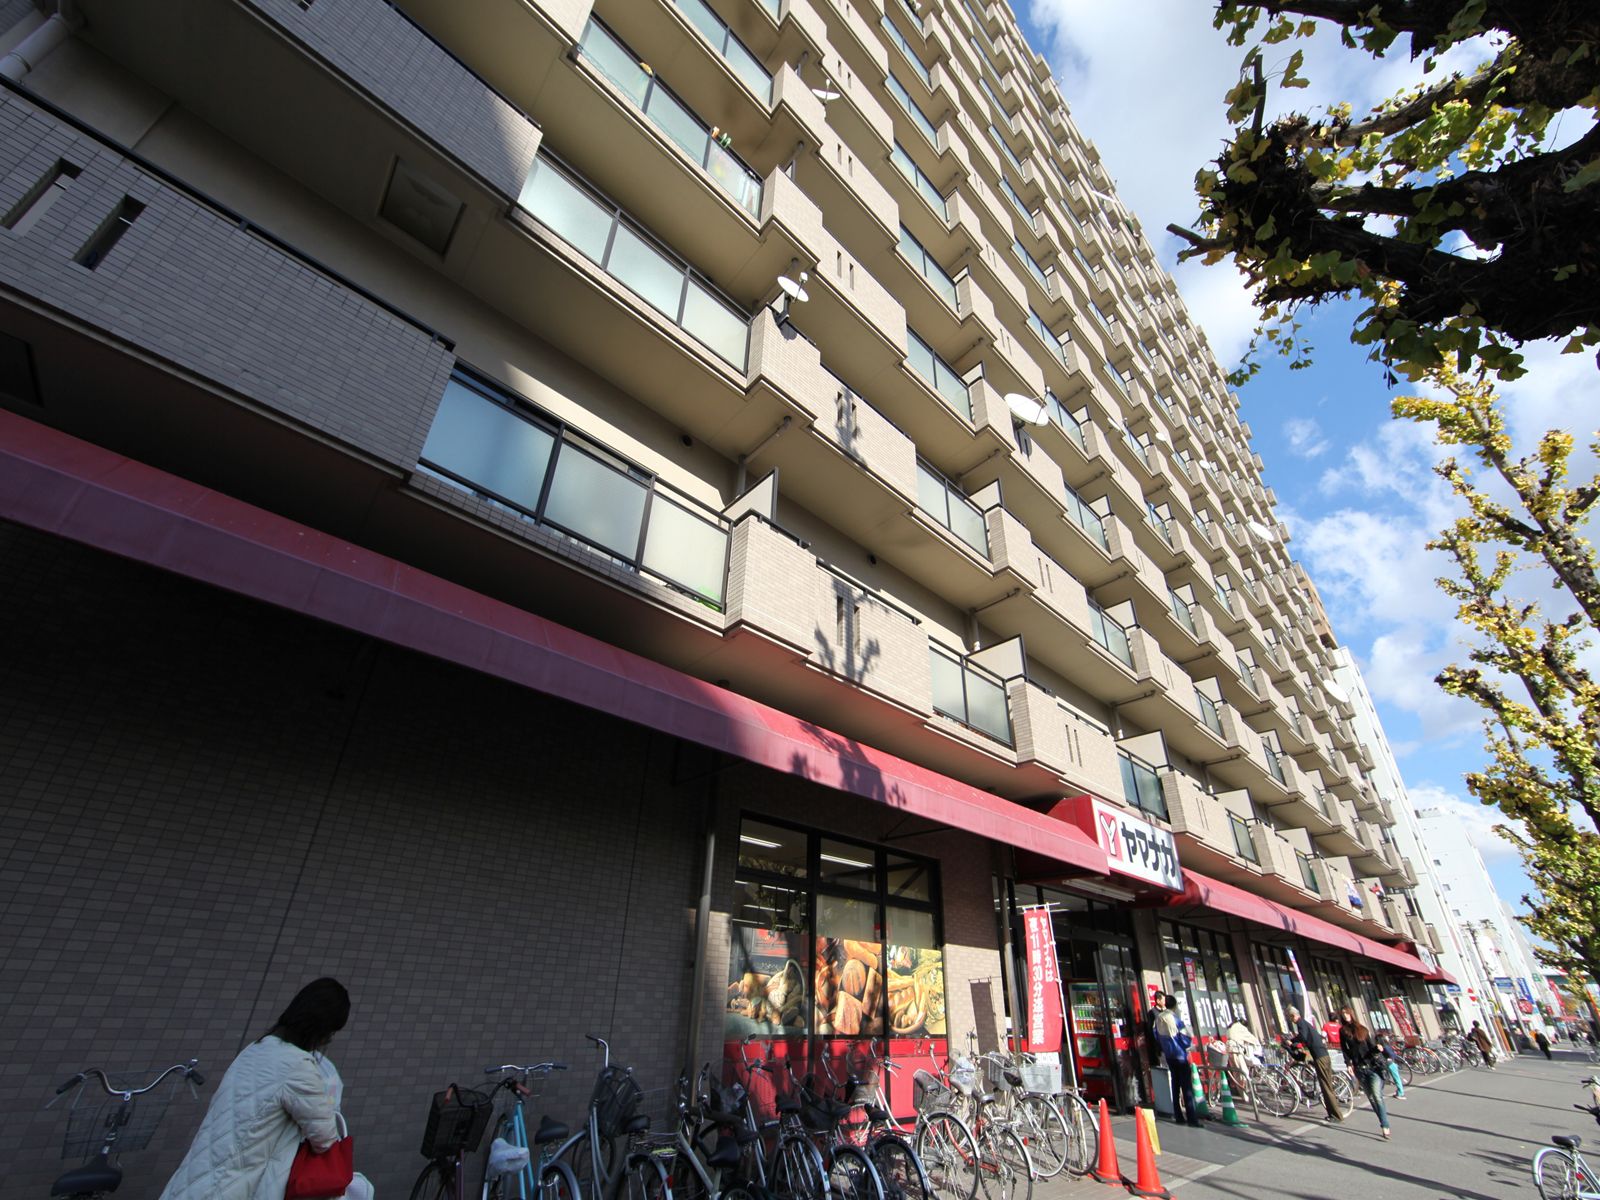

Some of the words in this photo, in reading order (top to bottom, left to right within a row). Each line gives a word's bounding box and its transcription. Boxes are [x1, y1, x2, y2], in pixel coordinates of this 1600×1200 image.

[1121, 821, 1176, 878] ヤマナカ
[1040, 916, 1054, 982] ヤマナカは
